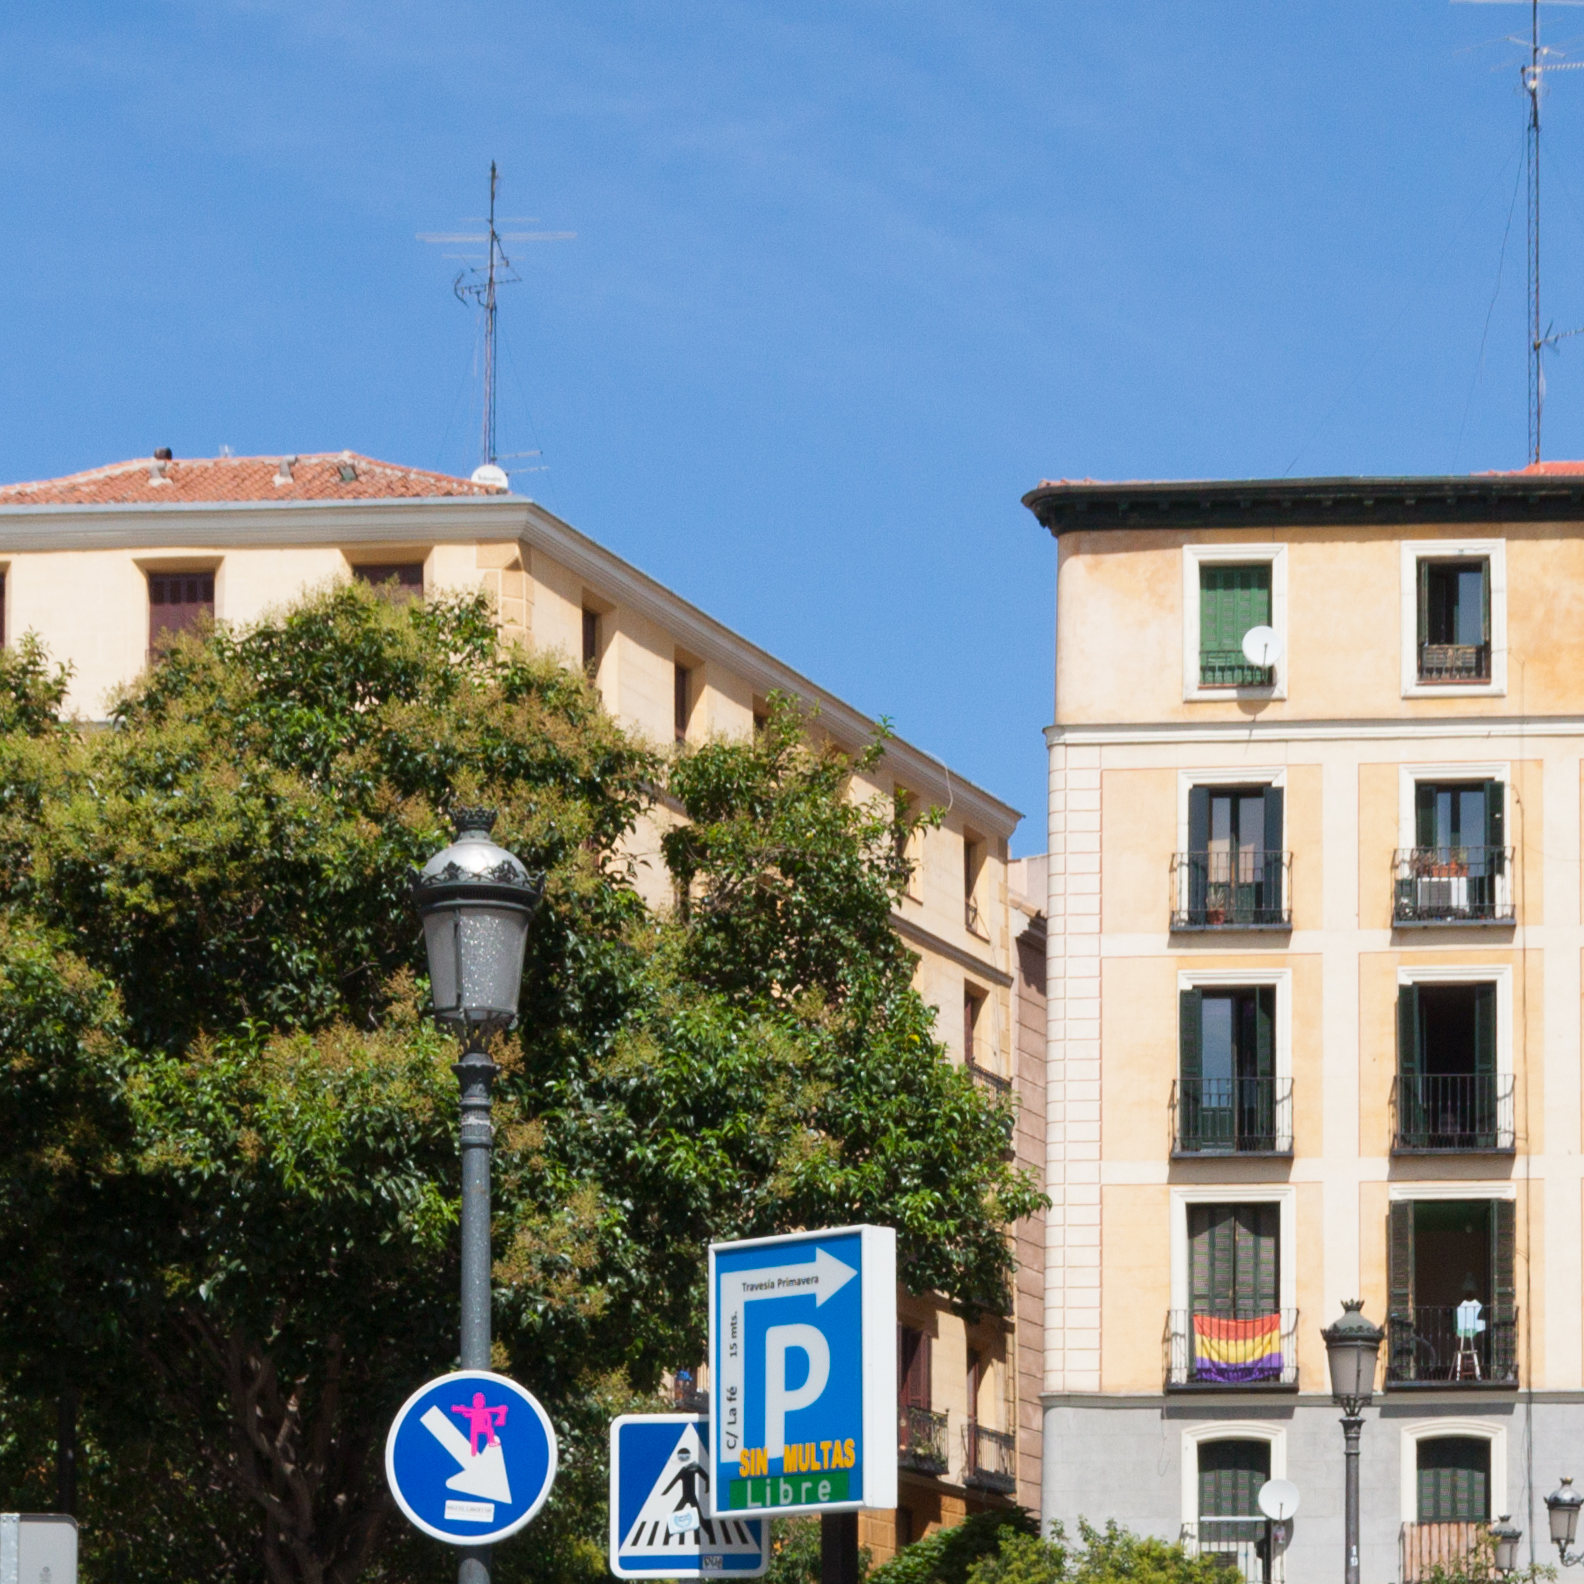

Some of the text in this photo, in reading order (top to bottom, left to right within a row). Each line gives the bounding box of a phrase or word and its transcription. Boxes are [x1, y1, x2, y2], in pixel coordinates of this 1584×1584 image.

[742, 1275, 819, 1292] Travesía Primavera
[729, 1342, 738, 1357] 15
[765, 1323, 830, 1460] P
[727, 1407, 737, 1425] La
[726, 1431, 738, 1450] C/
[739, 1438, 855, 1477] SIN MULTAS
[747, 1477, 831, 1508] Libre
